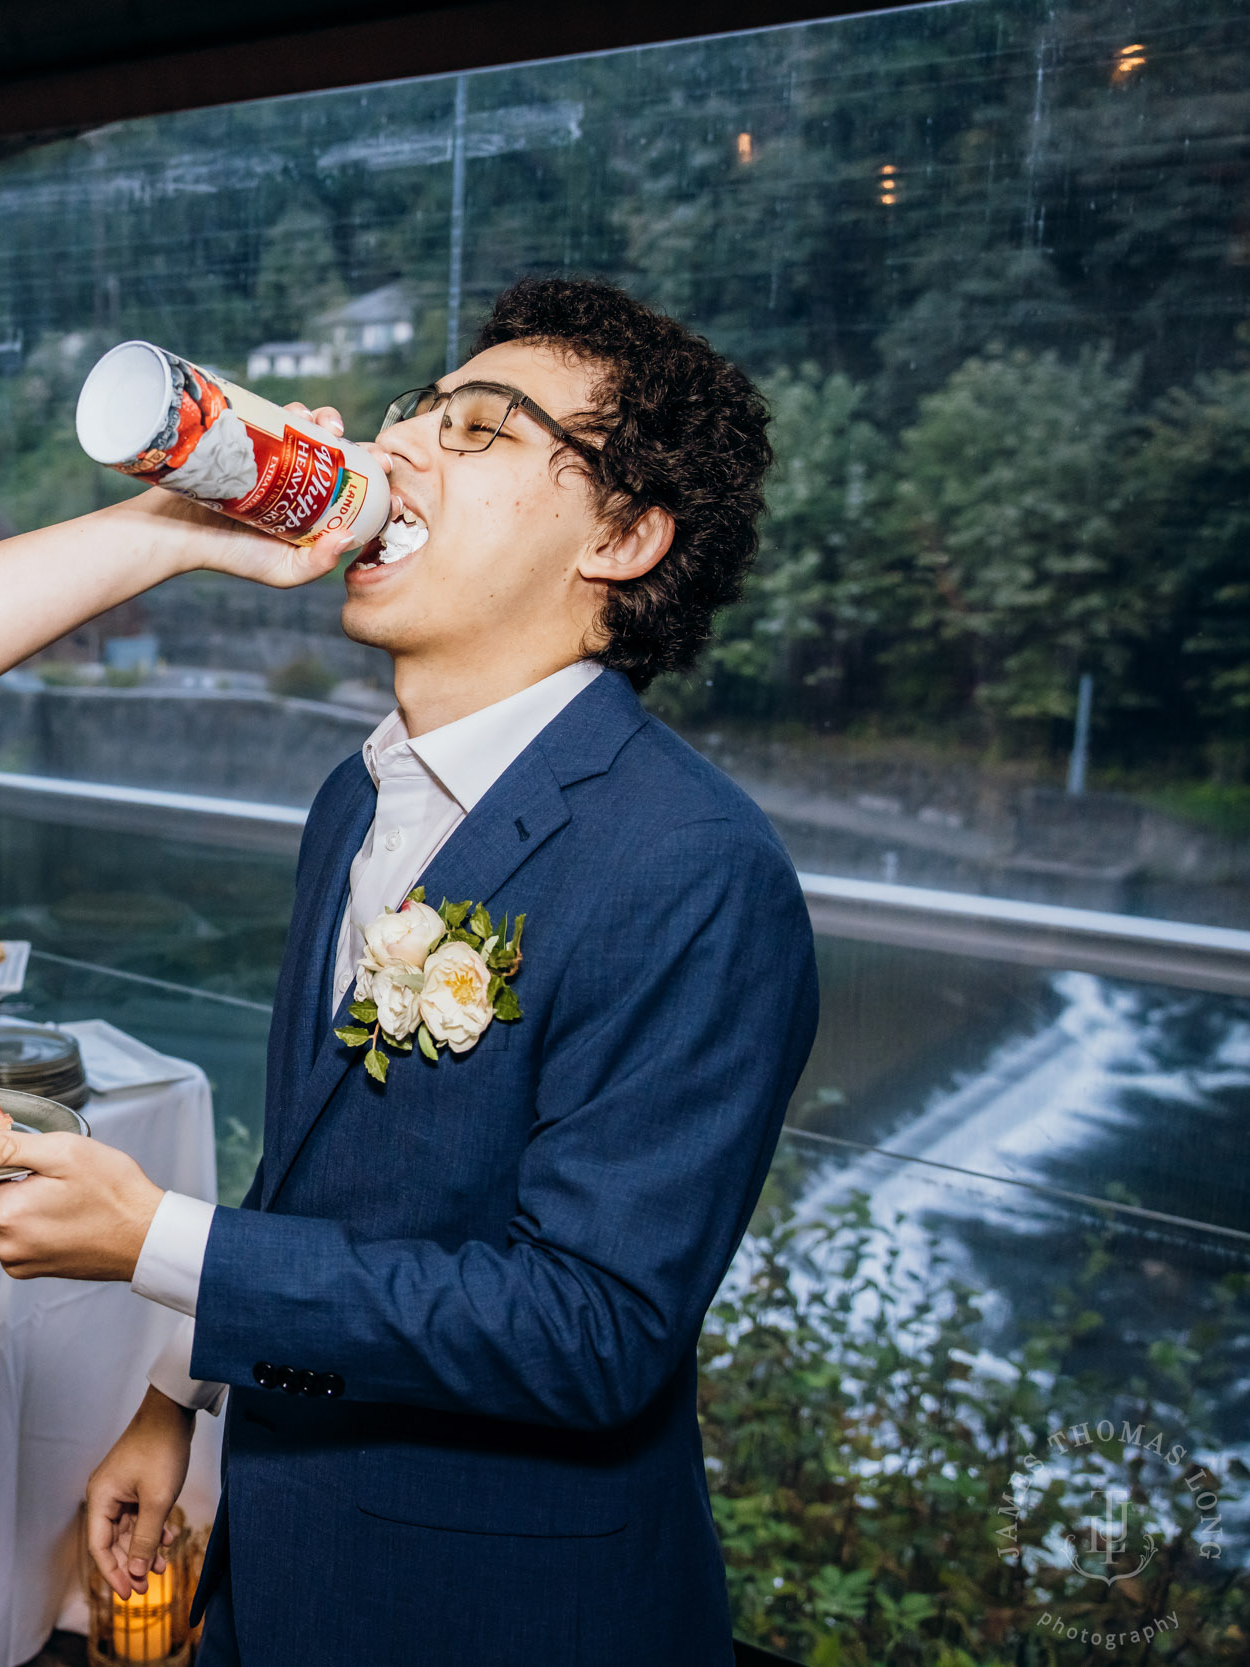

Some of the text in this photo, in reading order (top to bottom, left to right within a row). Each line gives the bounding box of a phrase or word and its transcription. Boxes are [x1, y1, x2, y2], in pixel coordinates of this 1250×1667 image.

[262, 456, 279, 487] EXTRA
[286, 440, 309, 499] HEAVY
[339, 483, 358, 515] LAND
[326, 515, 343, 530] O
